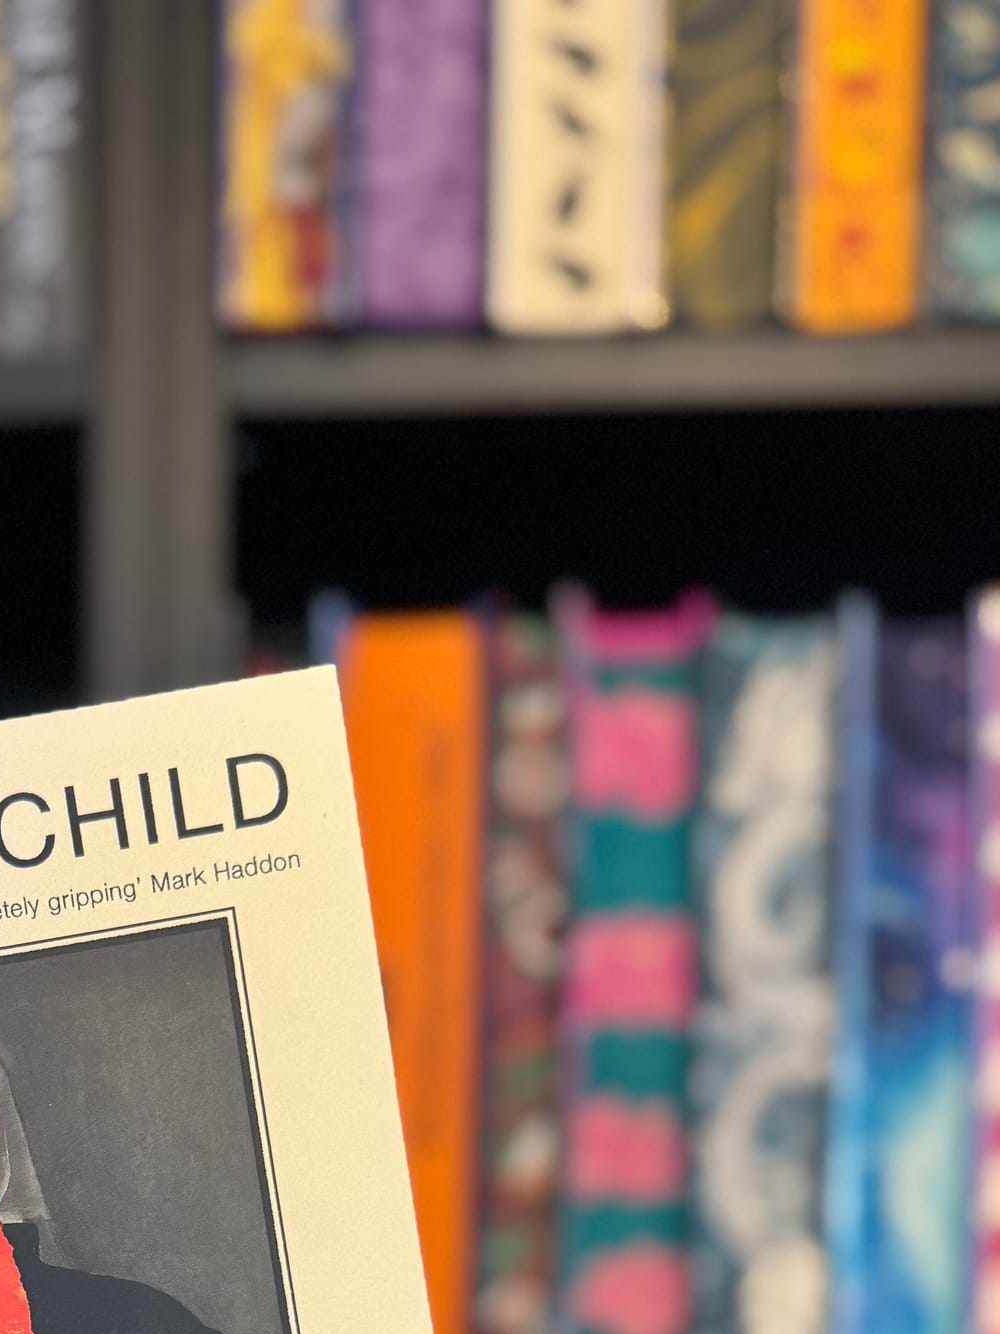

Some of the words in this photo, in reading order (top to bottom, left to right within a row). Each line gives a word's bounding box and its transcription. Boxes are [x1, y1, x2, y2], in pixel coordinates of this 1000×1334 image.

[48, 878, 141, 916] gripping’
[151, 868, 207, 894] Mark
[214, 852, 301, 883] Haddon
